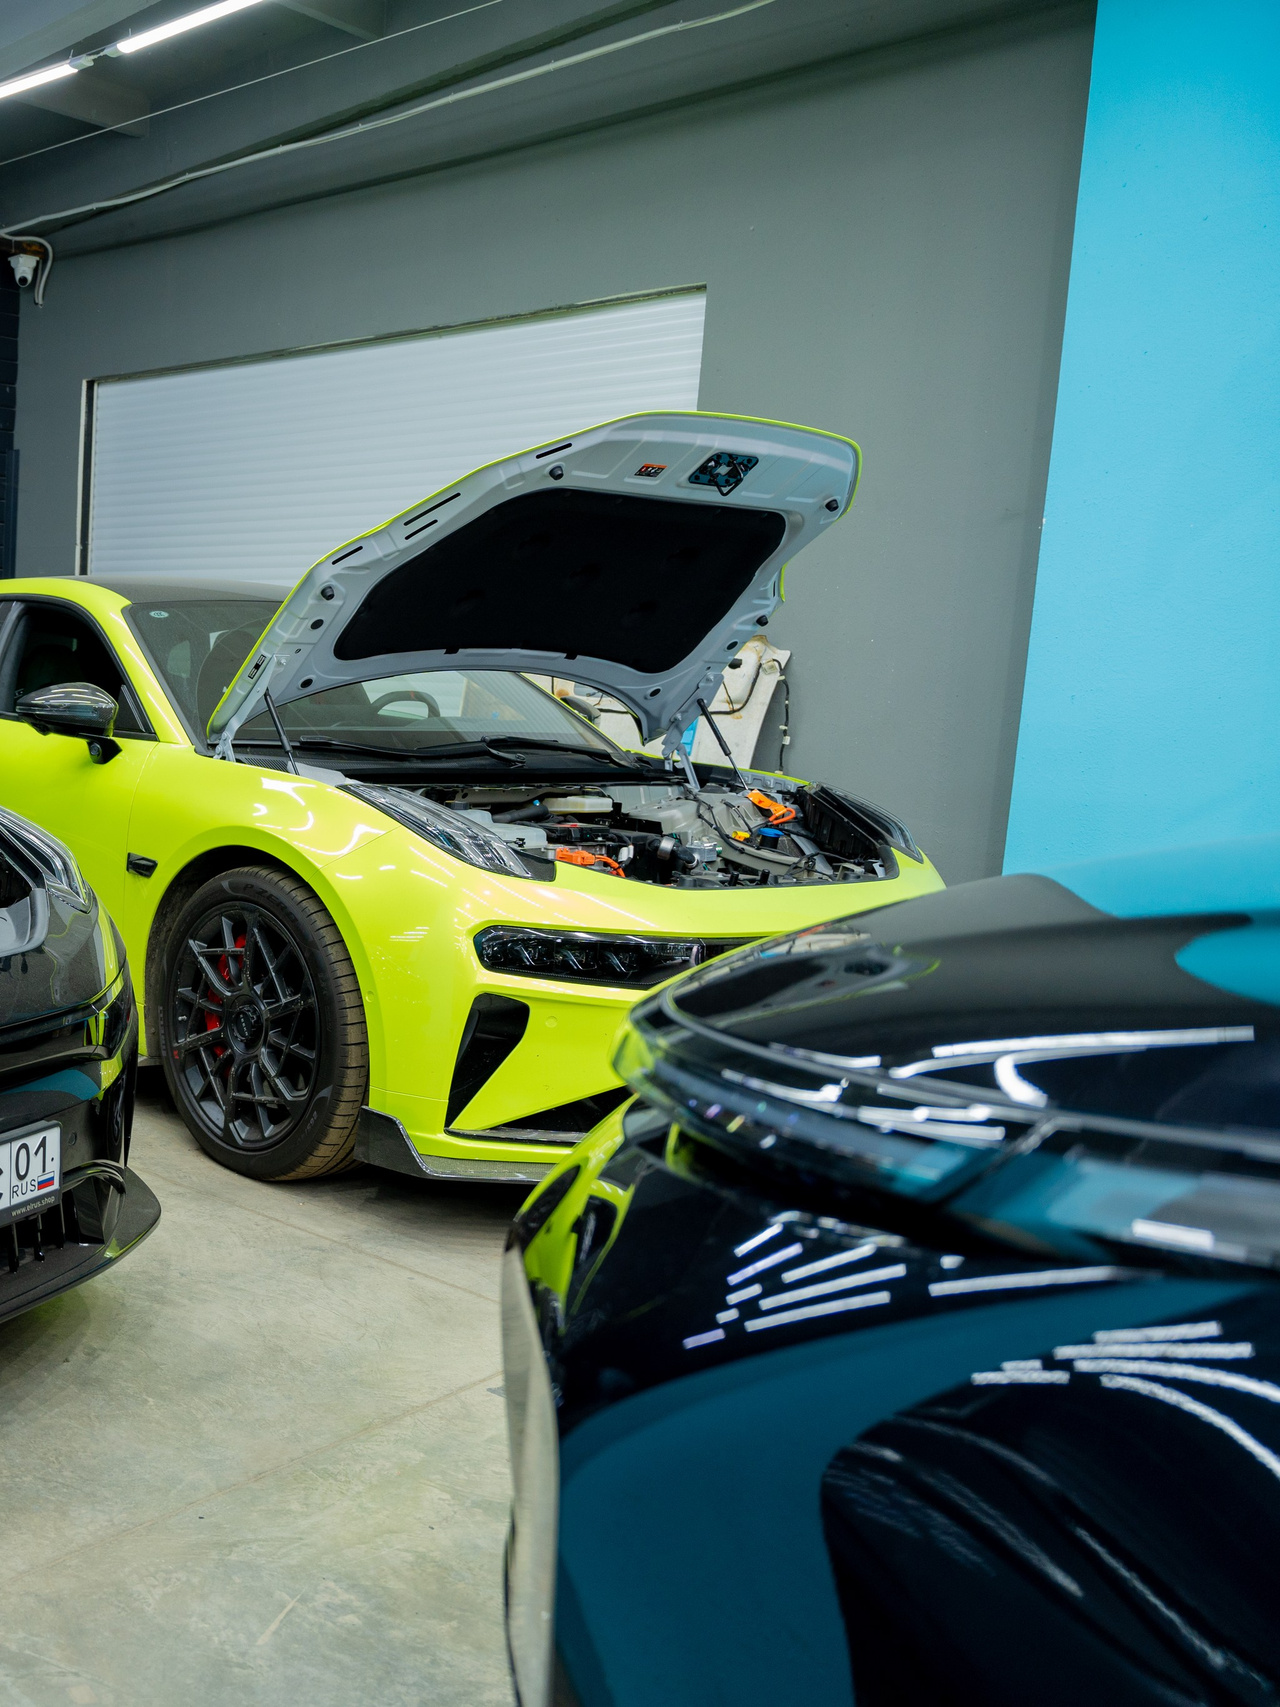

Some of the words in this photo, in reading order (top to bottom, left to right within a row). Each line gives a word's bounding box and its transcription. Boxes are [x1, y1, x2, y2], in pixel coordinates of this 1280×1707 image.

[15, 1135, 47, 1181] 01
[12, 1178, 37, 1199] RUS
[11, 1195, 55, 1217] www.elrus.shop
